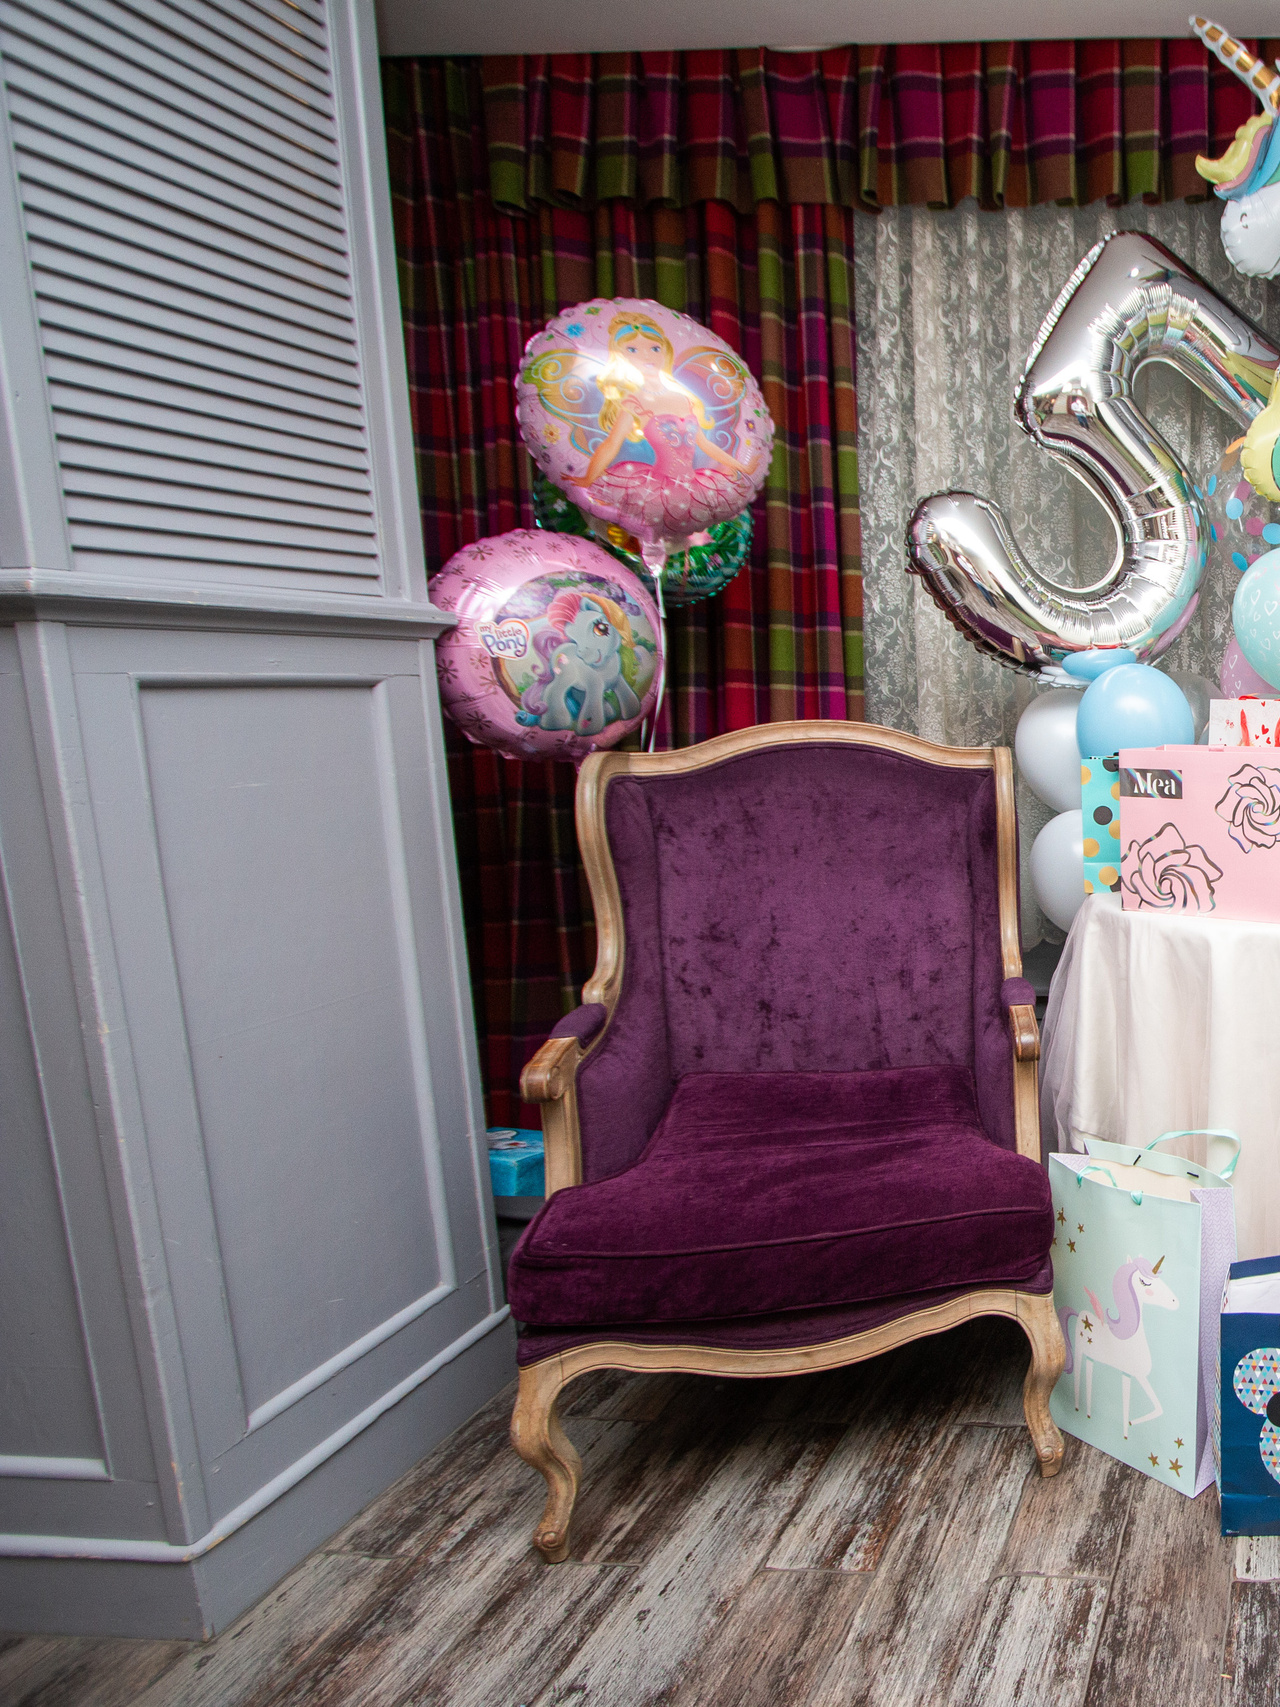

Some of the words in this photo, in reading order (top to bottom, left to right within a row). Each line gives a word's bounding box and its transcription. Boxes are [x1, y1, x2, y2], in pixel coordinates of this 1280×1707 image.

[494, 626, 523, 640] little
[482, 634, 528, 657] Pony
[1133, 771, 1177, 796] Mea
